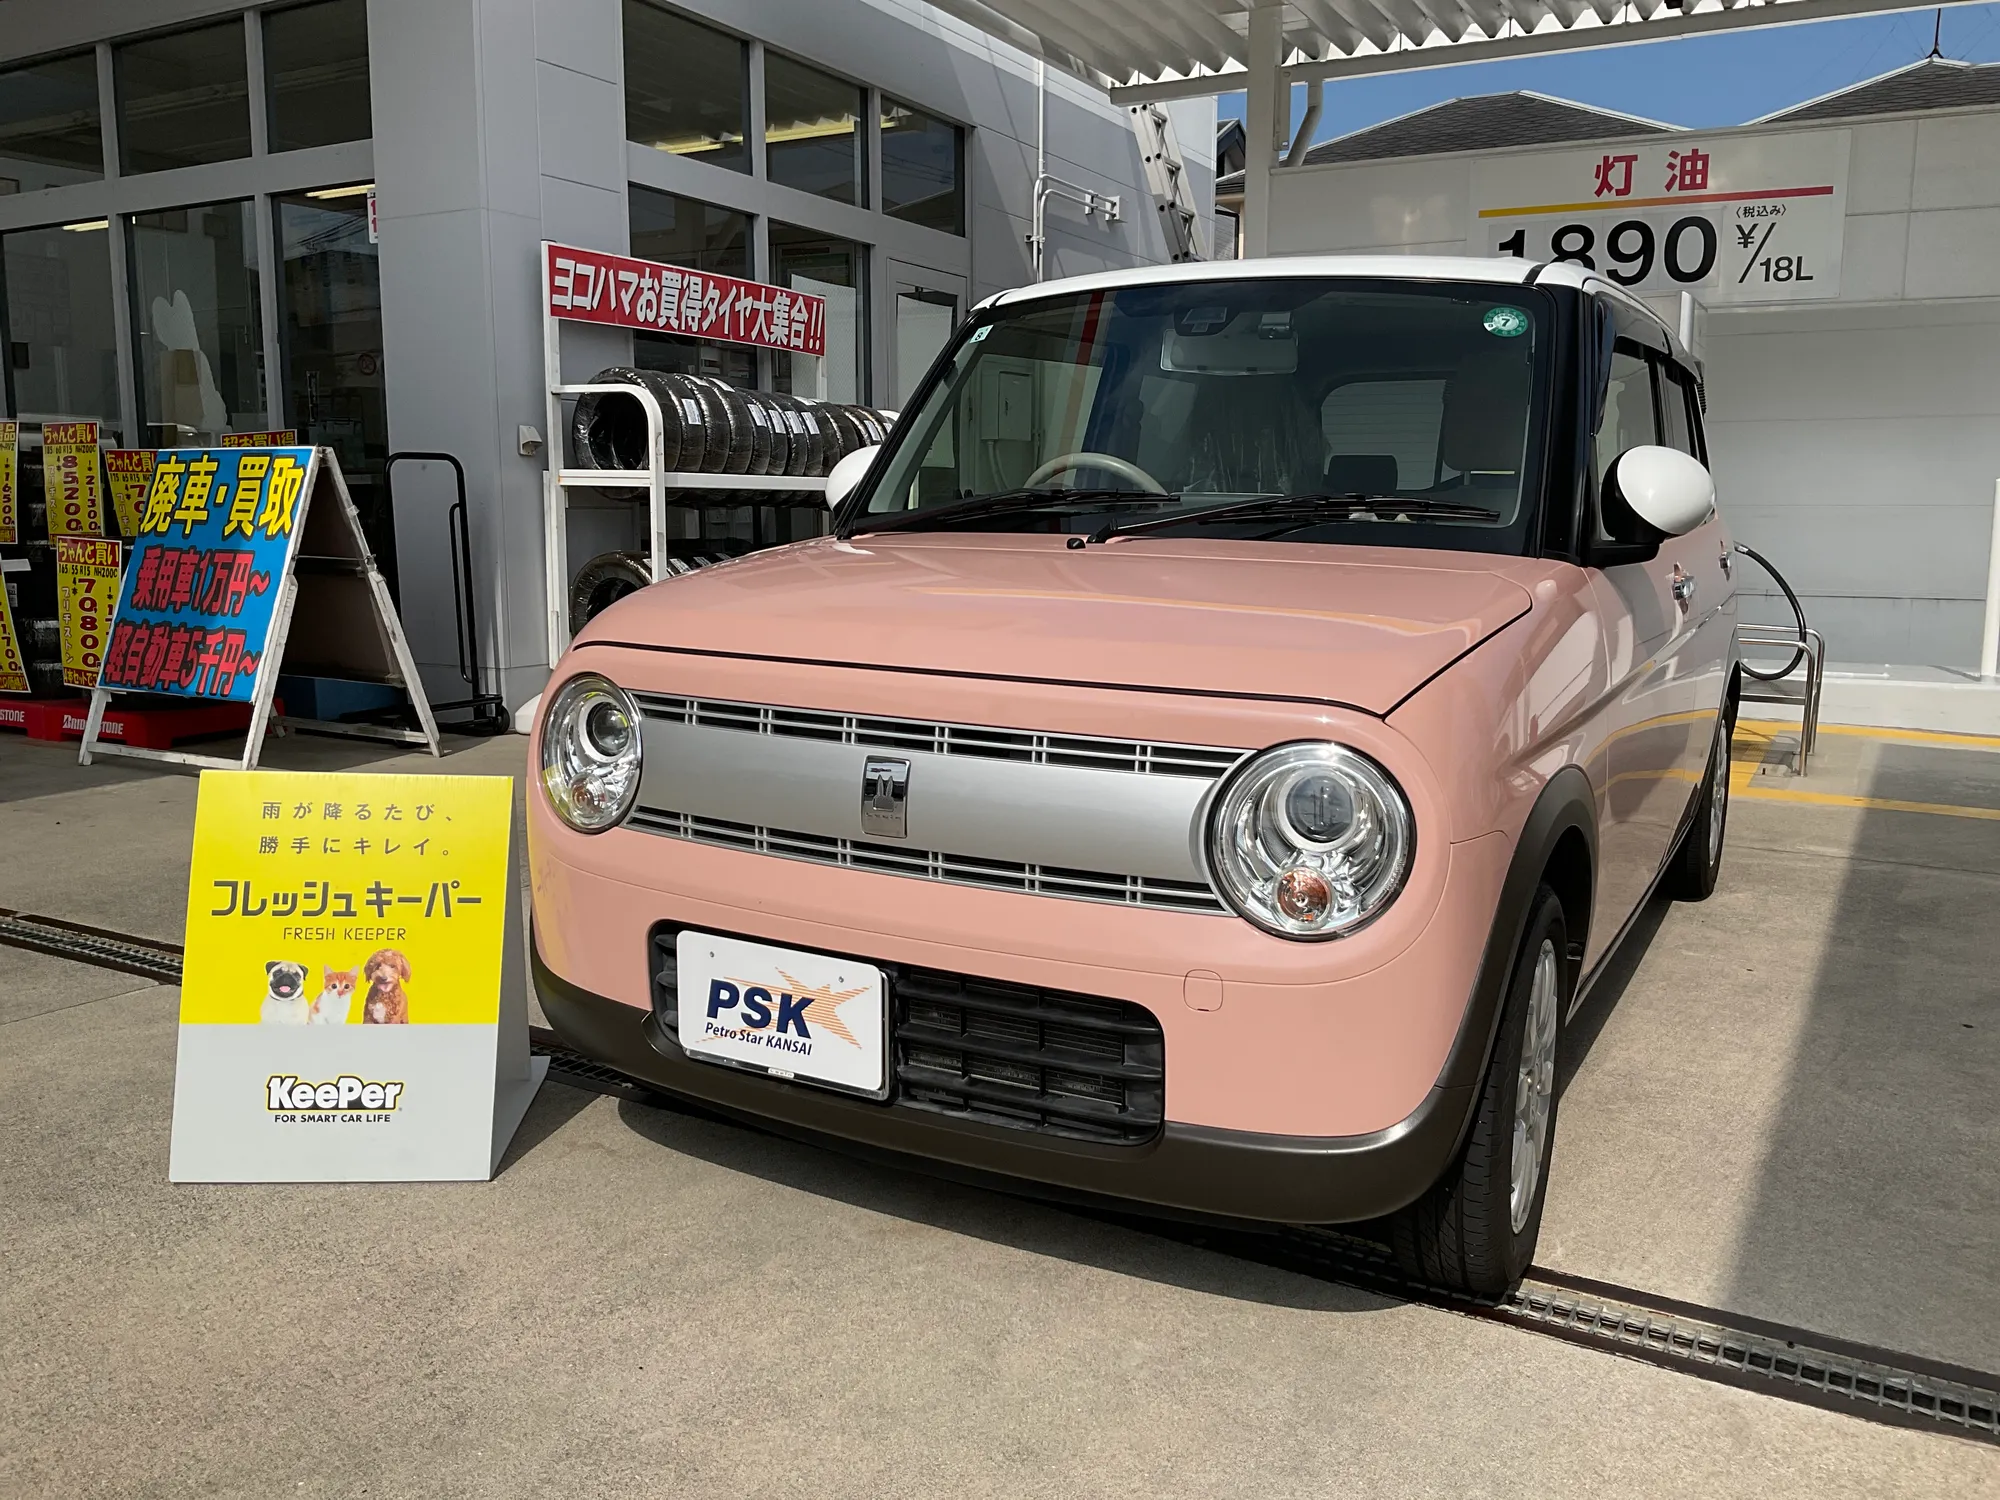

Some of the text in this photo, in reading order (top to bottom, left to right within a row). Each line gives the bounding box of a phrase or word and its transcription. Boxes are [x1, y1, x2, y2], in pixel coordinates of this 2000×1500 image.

[1594, 148, 1710, 197] 灯油
[551, 257, 823, 351] ヨコハマお買得タイヤ大集合!!
[44, 424, 97, 443] ちゃんと買い
[140, 455, 304, 537] 廃車・買取
[58, 541, 118, 565] ちゃんと買い
[62, 715, 124, 734] BRIDTONE
[262, 802, 454, 821] 雨が降るたび、
[259, 836, 449, 856] 勝手にキレイ。
[211, 880, 482, 918] フレッシュキーパー
[283, 927, 406, 941] FRESH KEEPER
[706, 978, 815, 1039] PSK
[705, 1022, 813, 1056] Petro Star KANSAI
[267, 1075, 404, 1110] KeePer
[274, 1114, 391, 1123] FOR SMART CAR LIFE
